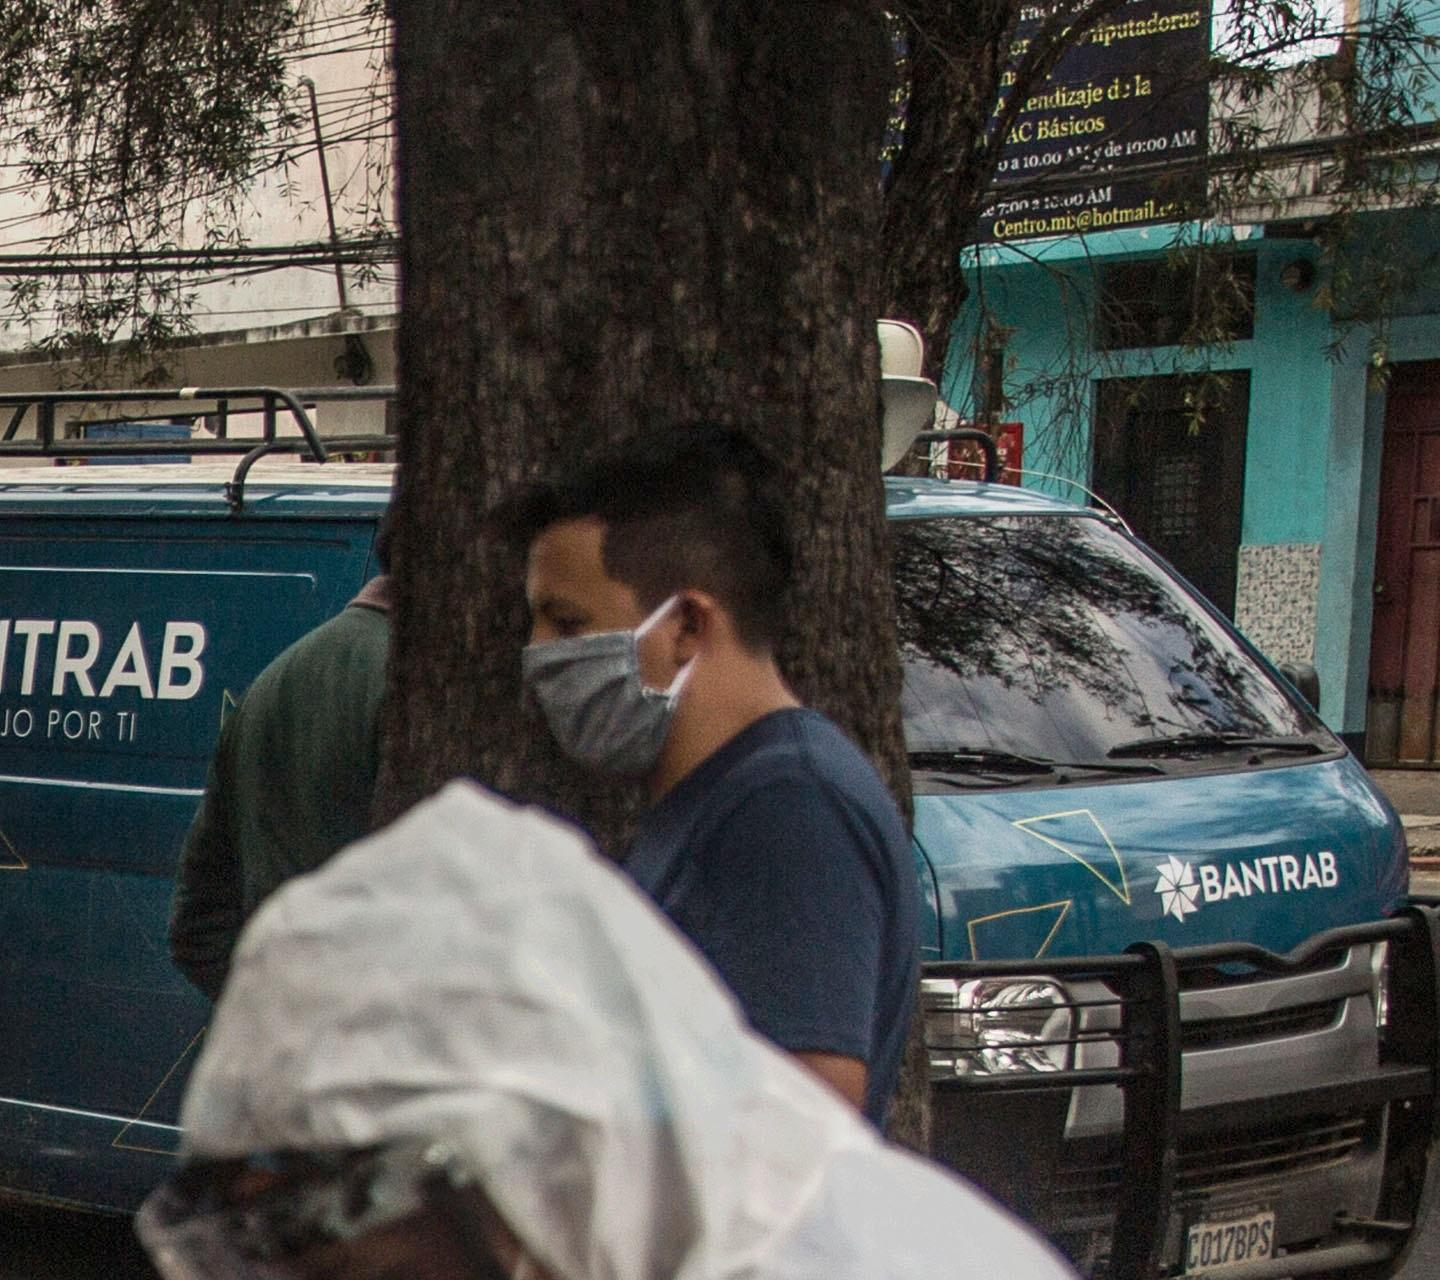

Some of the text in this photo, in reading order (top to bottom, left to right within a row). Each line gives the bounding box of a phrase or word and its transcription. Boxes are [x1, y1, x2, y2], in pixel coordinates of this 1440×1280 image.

[1134, 74, 1152, 97] la
[1036, 115, 1105, 141] Básicos
[1104, 141, 1122, 158] de
[1169, 129, 1197, 149] AM
[1087, 185, 1112, 204] AM
[47, 709, 102, 741] POR
[117, 711, 137, 742] TI
[1199, 851, 1339, 902] BANTRAB
[1188, 1220, 1272, 1269] C017BPS
